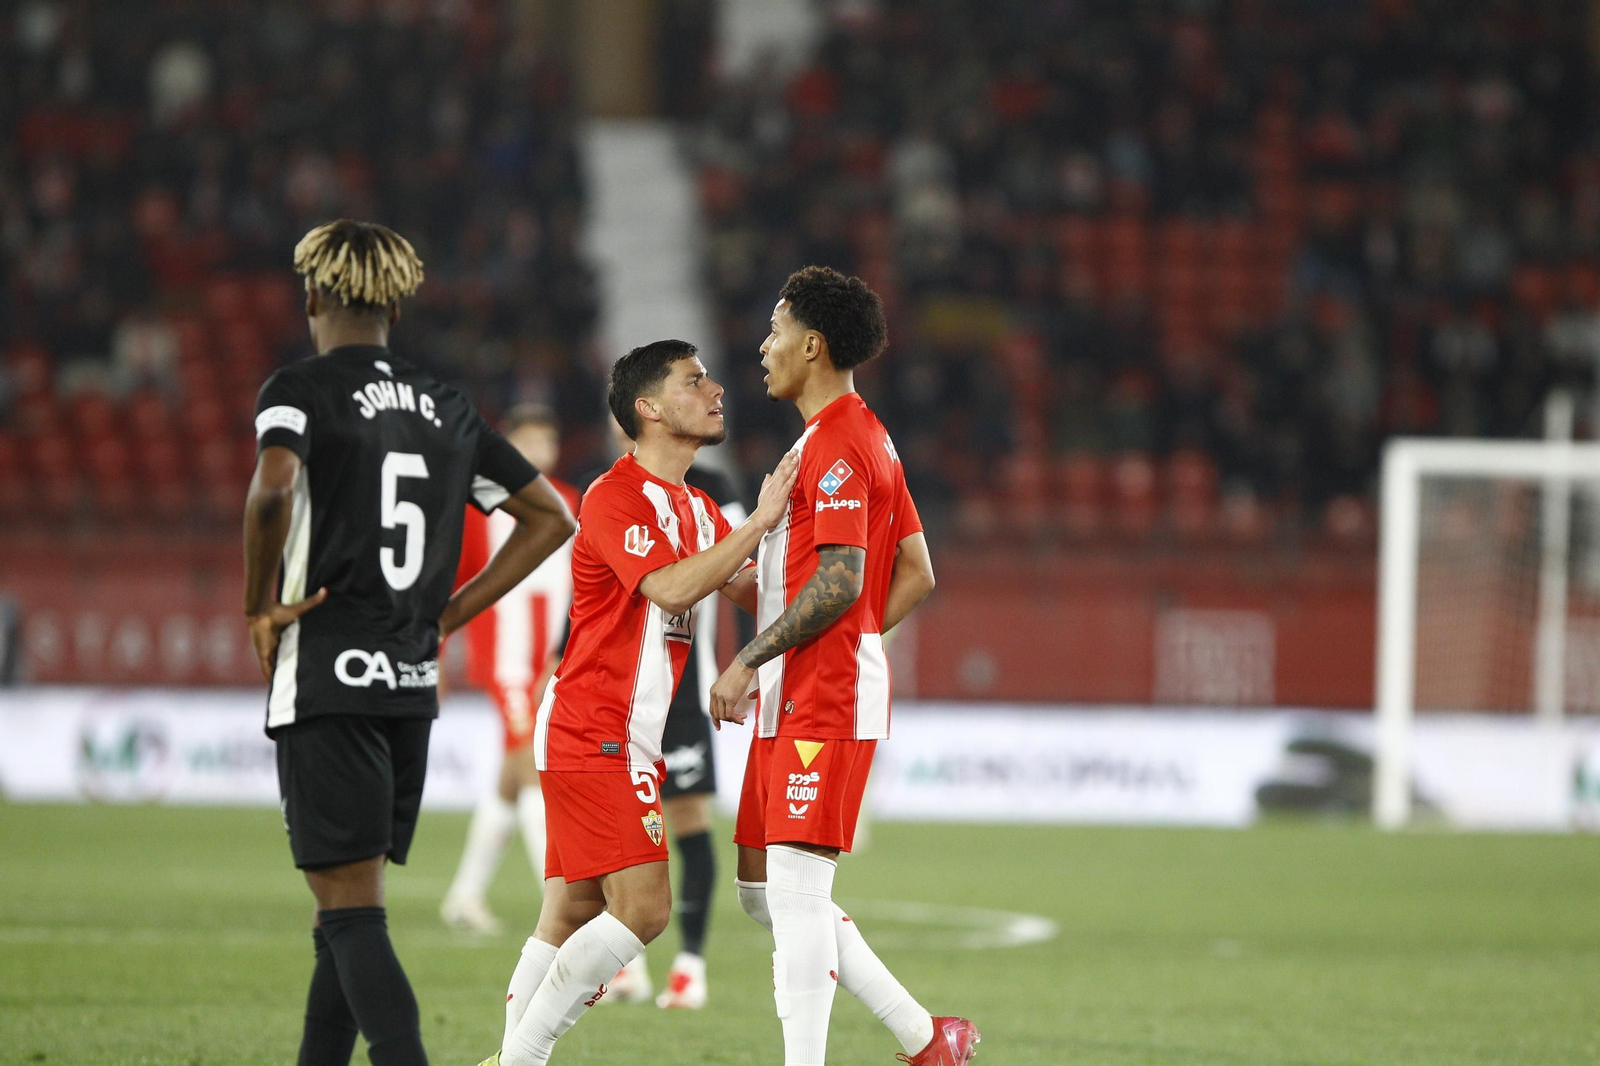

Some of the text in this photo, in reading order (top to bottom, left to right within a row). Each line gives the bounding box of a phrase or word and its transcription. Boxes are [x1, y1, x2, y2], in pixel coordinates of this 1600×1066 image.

[352, 380, 442, 429] JOHN C.
[379, 451, 430, 591] 5
[334, 648, 397, 690] CA
[629, 771, 657, 804] 5
[786, 785, 818, 801] KUDU
